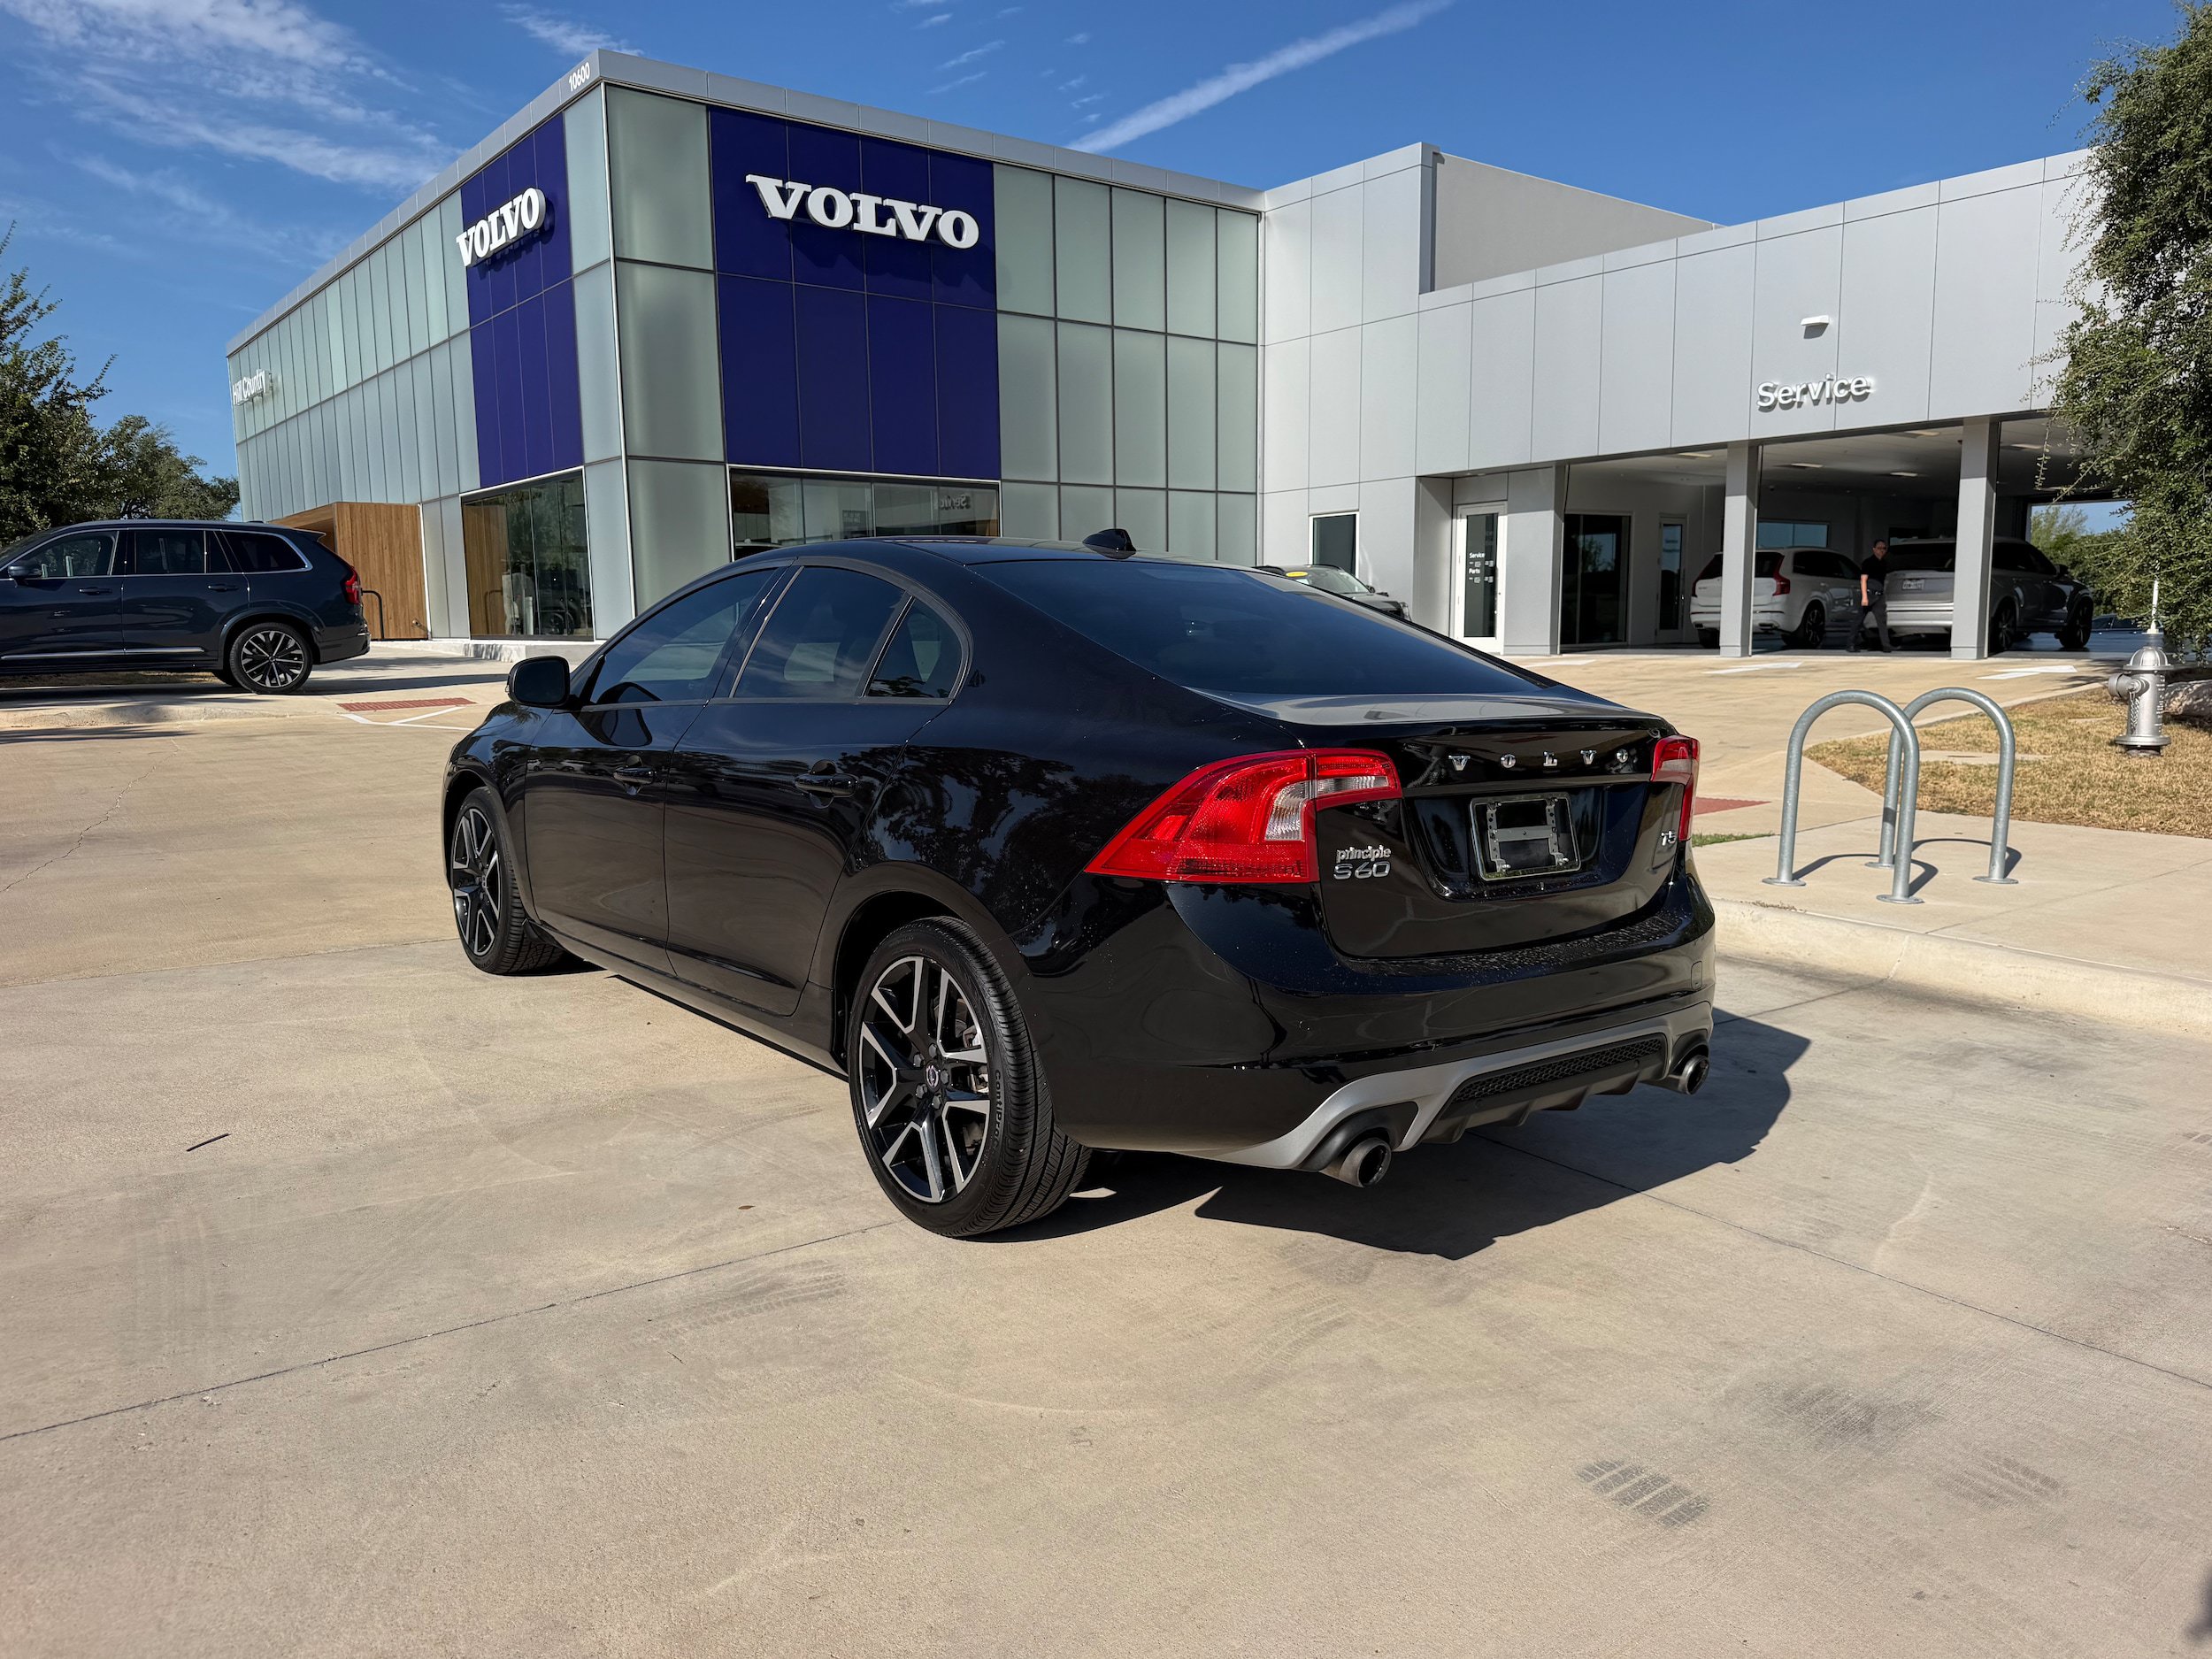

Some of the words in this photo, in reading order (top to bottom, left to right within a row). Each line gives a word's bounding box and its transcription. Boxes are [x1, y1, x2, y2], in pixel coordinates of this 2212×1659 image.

[569, 62, 590, 92] 10600
[746, 174, 979, 249] VOLVO
[456, 188, 545, 267] VOLVO
[1757, 373, 1870, 407] Service
[1448, 749, 1629, 772] VOLVO
[1661, 831, 1677, 846] T5
[1336, 844, 1392, 864] principle
[1333, 861, 1390, 879] S60
